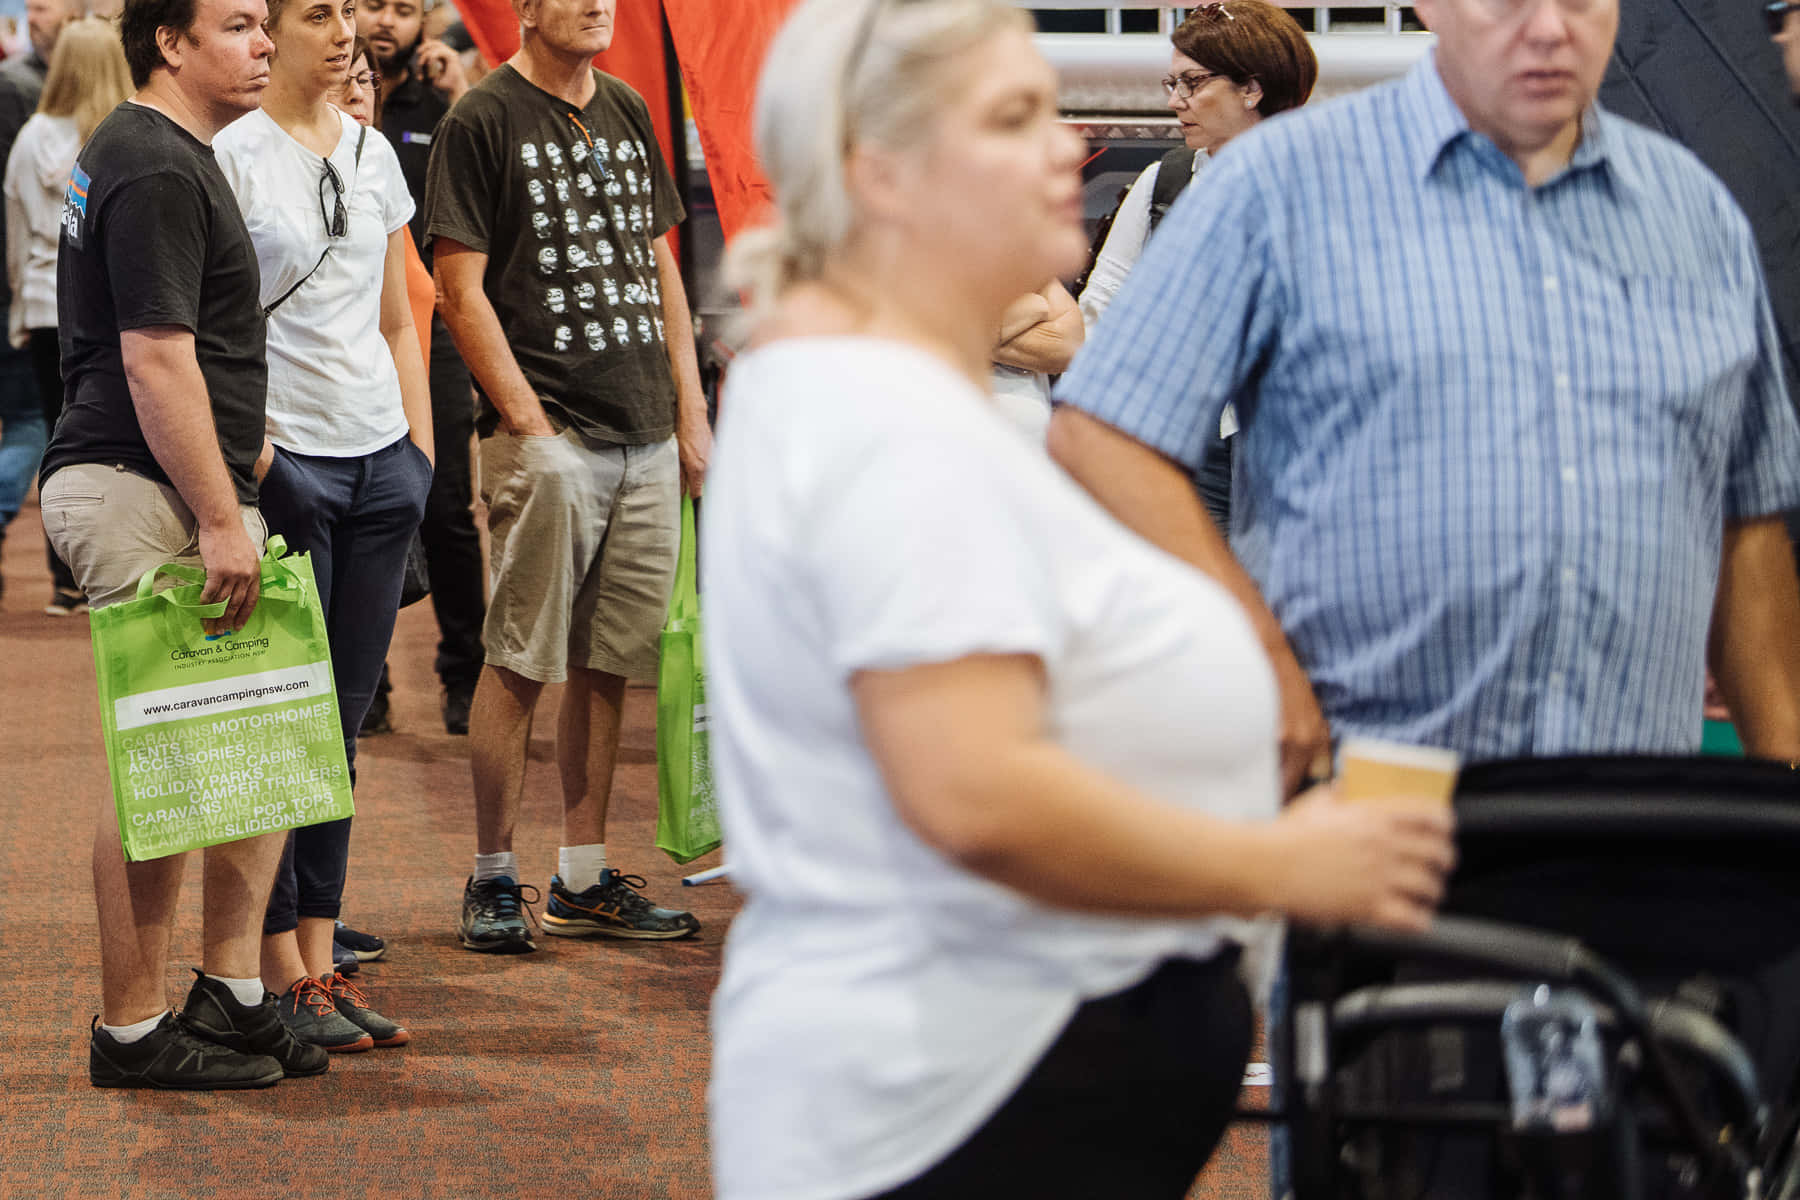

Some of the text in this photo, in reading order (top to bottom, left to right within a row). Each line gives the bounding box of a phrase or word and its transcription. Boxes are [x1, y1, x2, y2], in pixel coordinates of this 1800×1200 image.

[171, 637, 269, 661] Caravan & Camping
[208, 653, 250, 665] ASSOCIATION
[143, 680, 309, 716] www.caravancampingnsw.com
[122, 702, 331, 750] CARAVANS MOTORHOMES
[127, 742, 181, 763] TENTS
[128, 743, 246, 776] ACCESSORIES
[247, 746, 307, 768] CABINS
[134, 776, 206, 801] HOLIDAY
[209, 766, 264, 788] PARKS
[189, 765, 341, 804] CAMPER TRAILERS
[132, 801, 222, 826] CARAVANS
[254, 801, 287, 819] POP
[292, 792, 334, 811] TOPS
[225, 810, 306, 837] SLIDEONS
